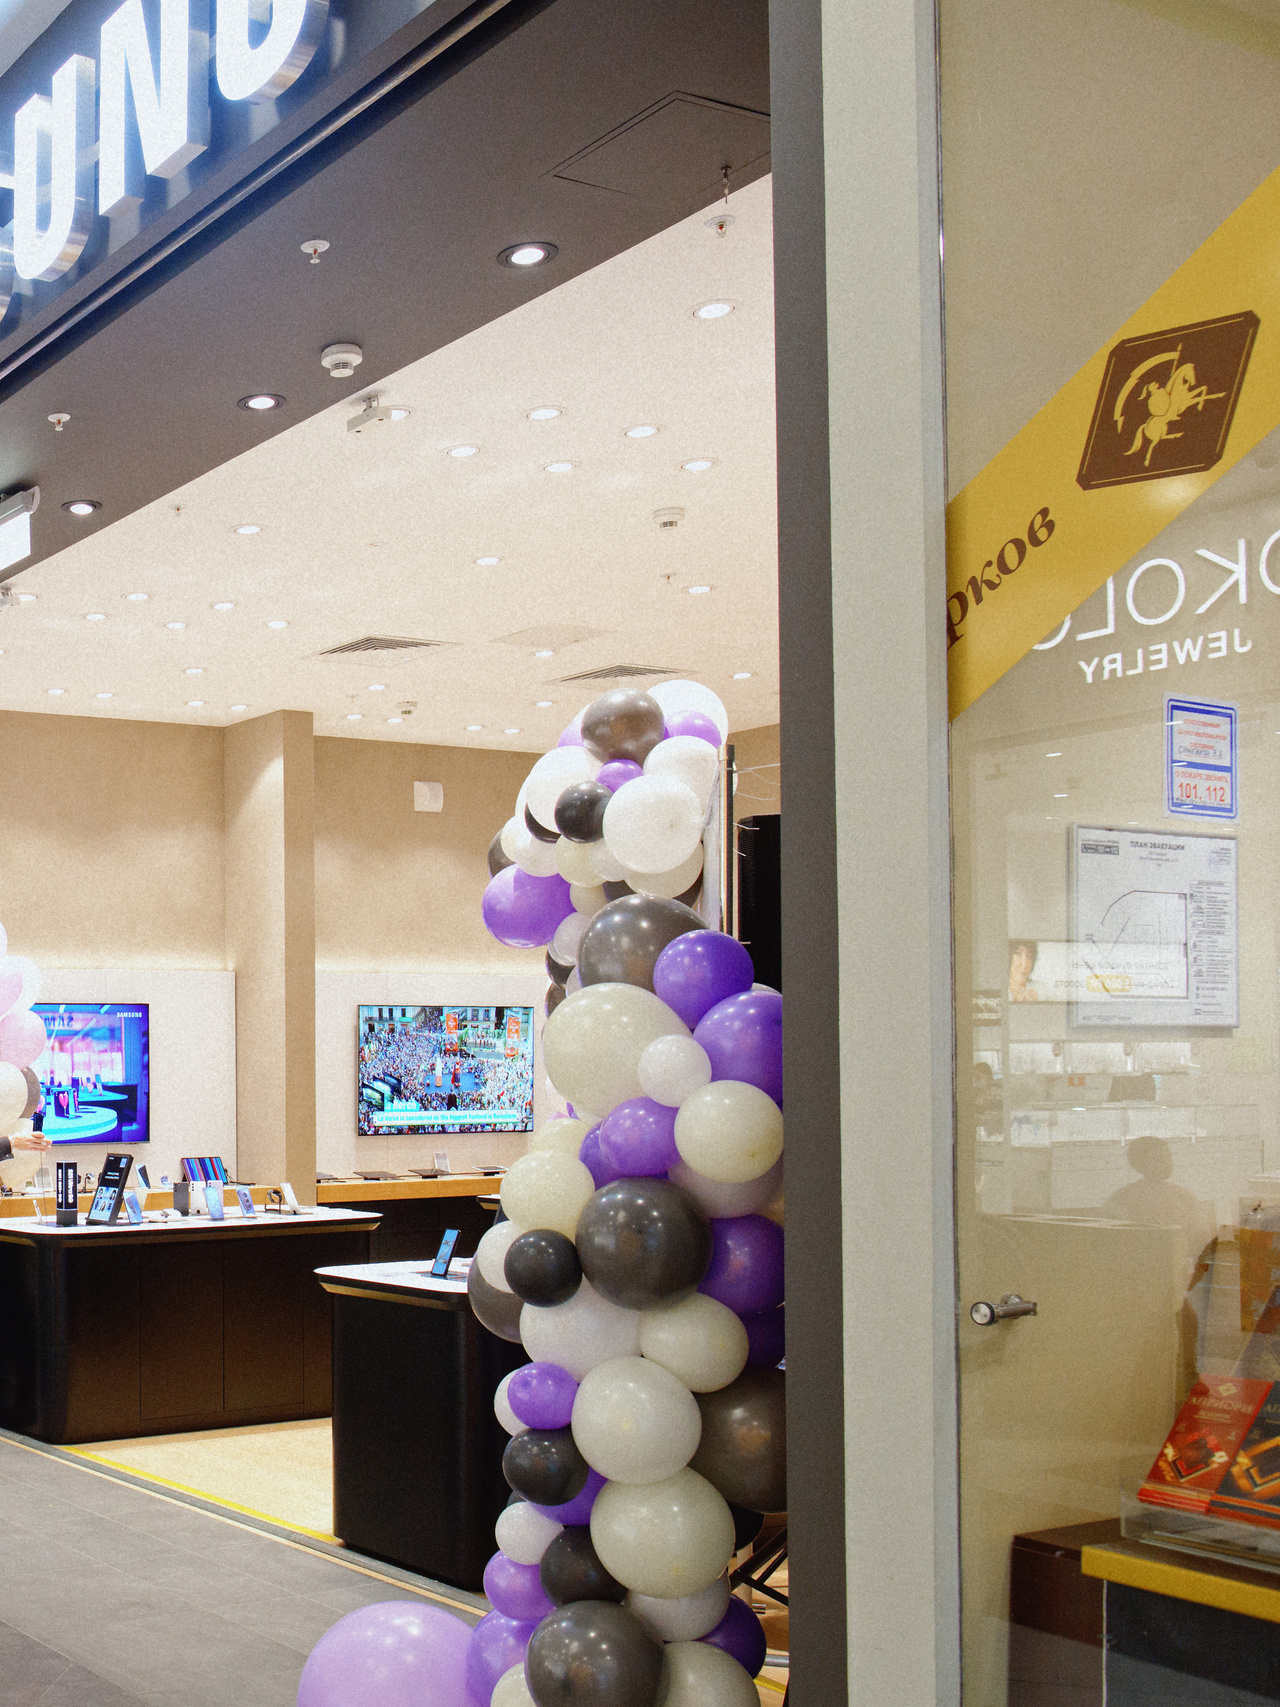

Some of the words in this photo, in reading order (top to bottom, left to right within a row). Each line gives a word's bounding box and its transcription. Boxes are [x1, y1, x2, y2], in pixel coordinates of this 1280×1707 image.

[1178, 782, 1202, 802] 101,
[1206, 785, 1226, 803] 112
[1130, 840, 1148, 849] ПЛАН
[1149, 842, 1186, 851] ЭВАКУАЦИИ
